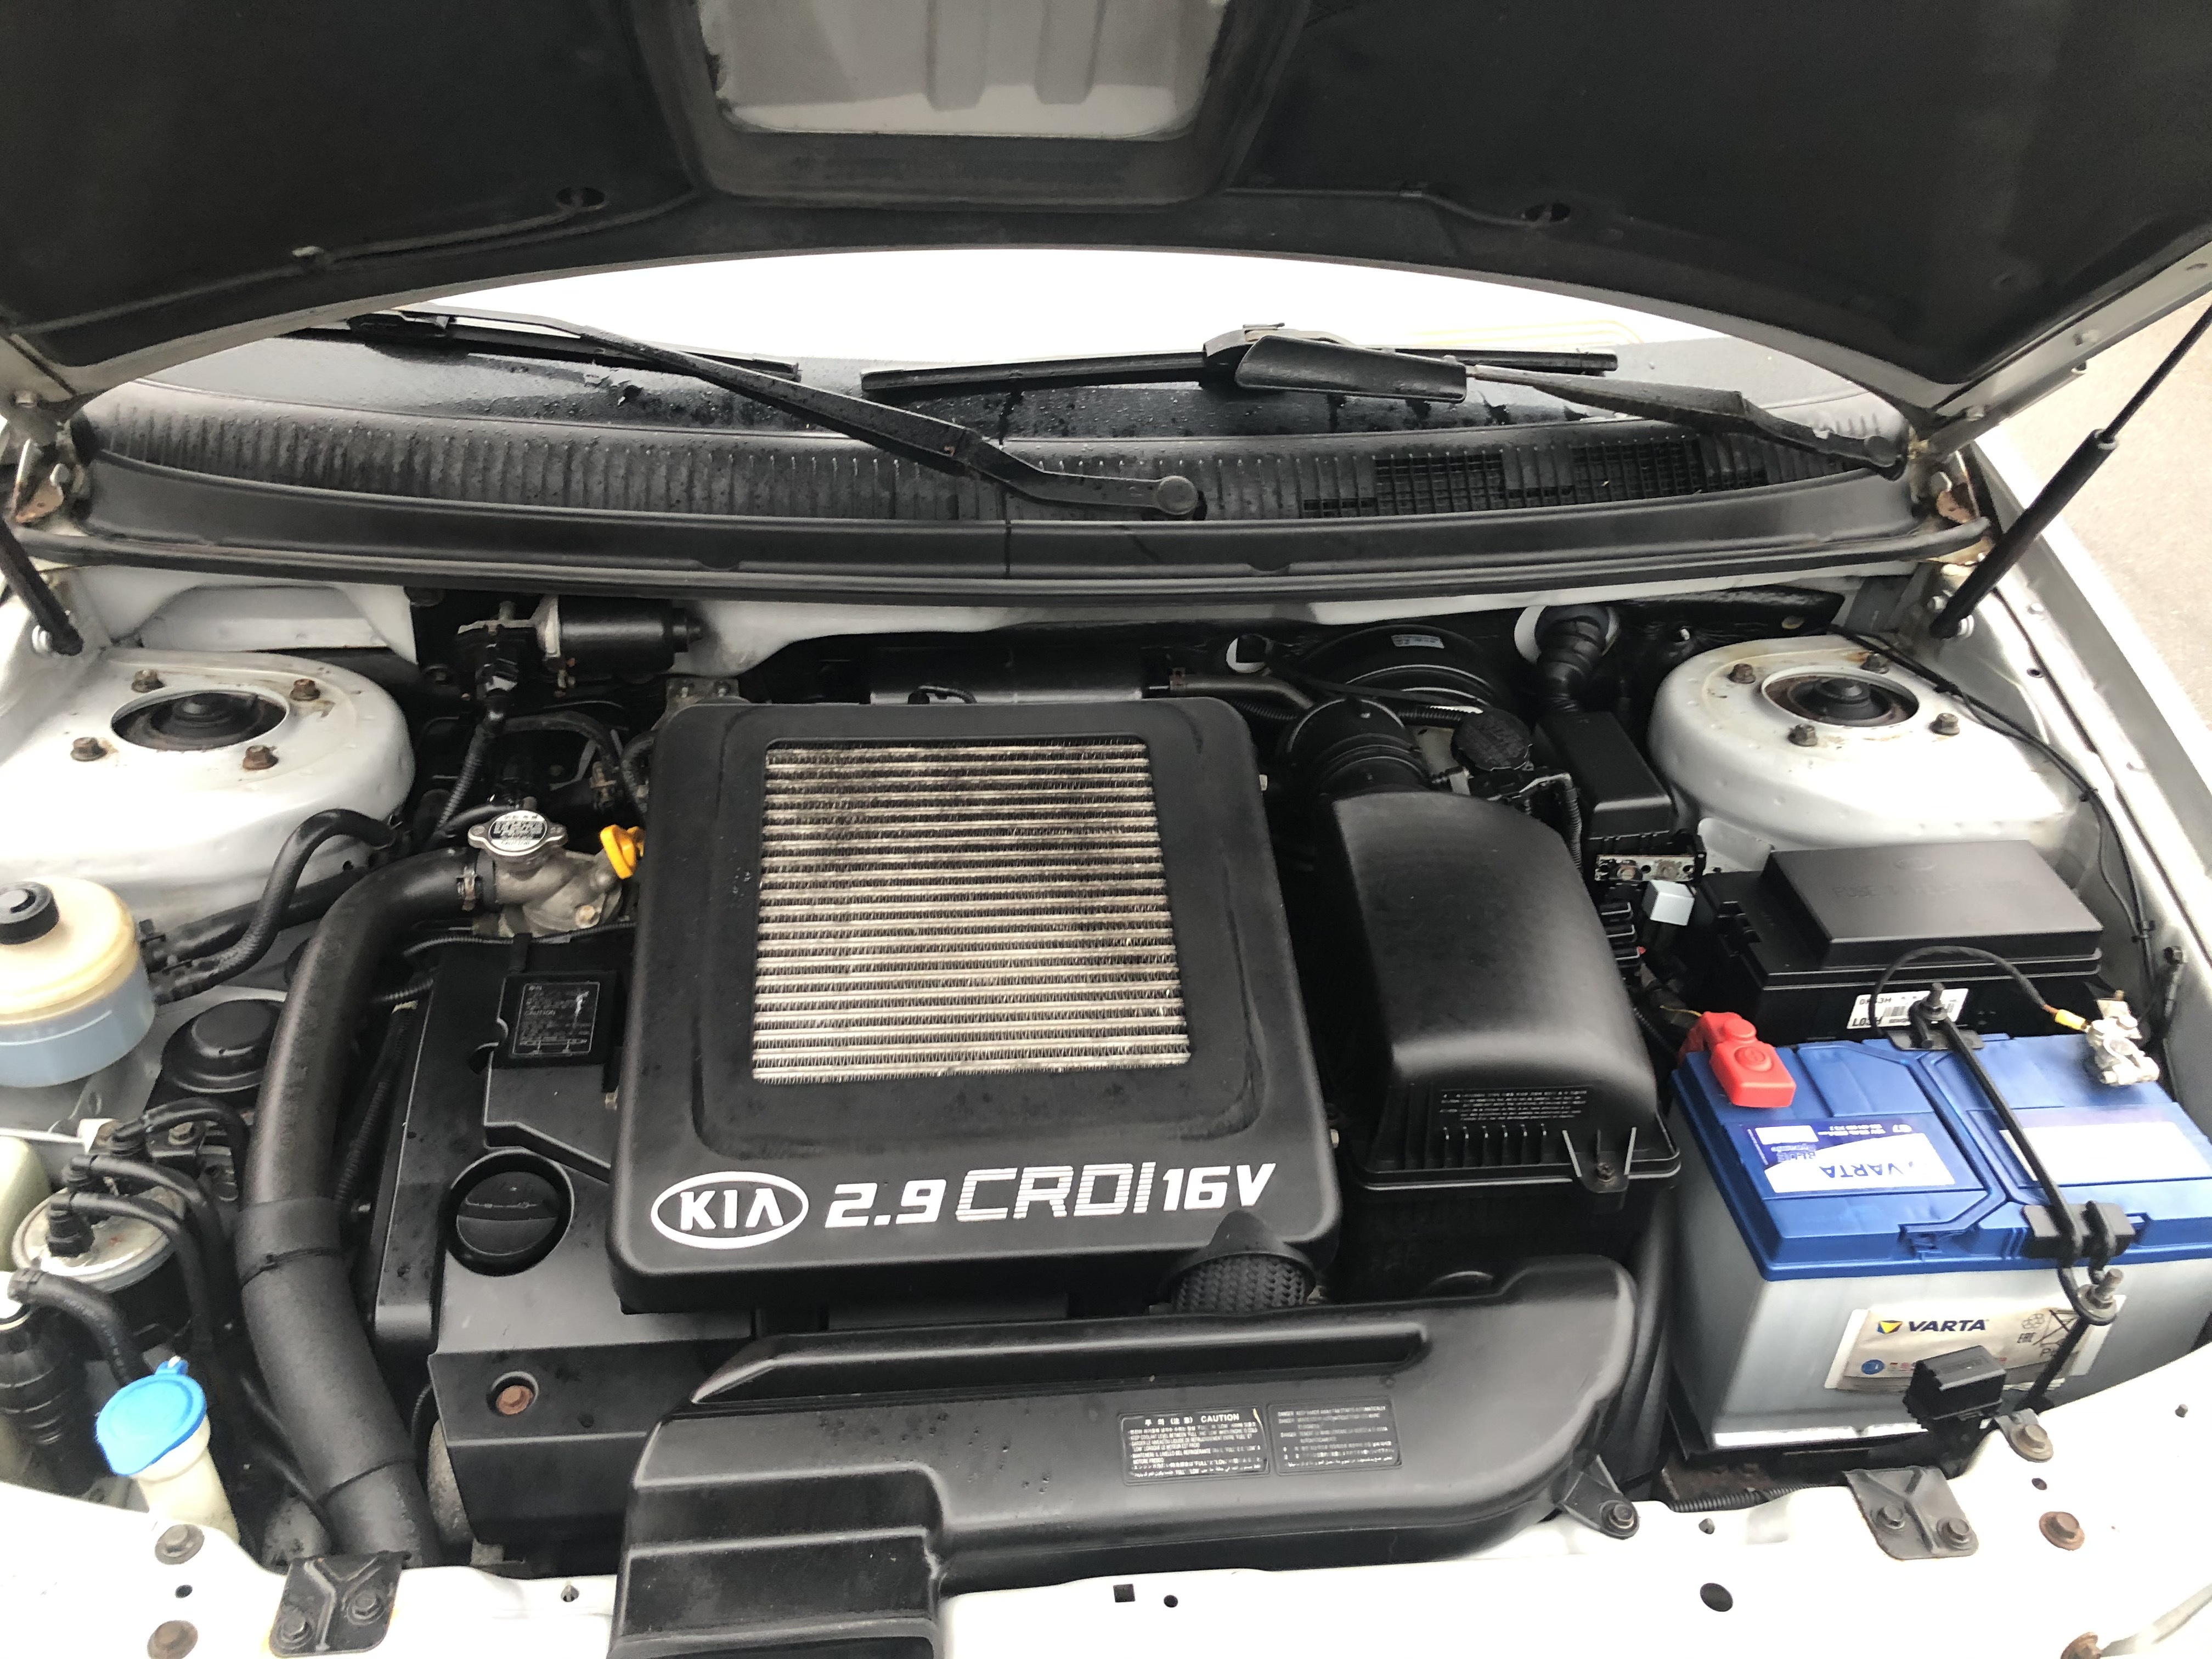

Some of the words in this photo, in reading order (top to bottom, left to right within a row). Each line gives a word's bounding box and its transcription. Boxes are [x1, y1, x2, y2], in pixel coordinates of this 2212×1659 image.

[1819, 1163, 1904, 1178] VARTA
[680, 1190, 784, 1231] KIA
[825, 1178, 947, 1230] 2.9
[1162, 1163, 1278, 1211] 16V
[1908, 1319, 1987, 1333] VARTA
[1200, 1413, 1240, 1423] CAUTION
